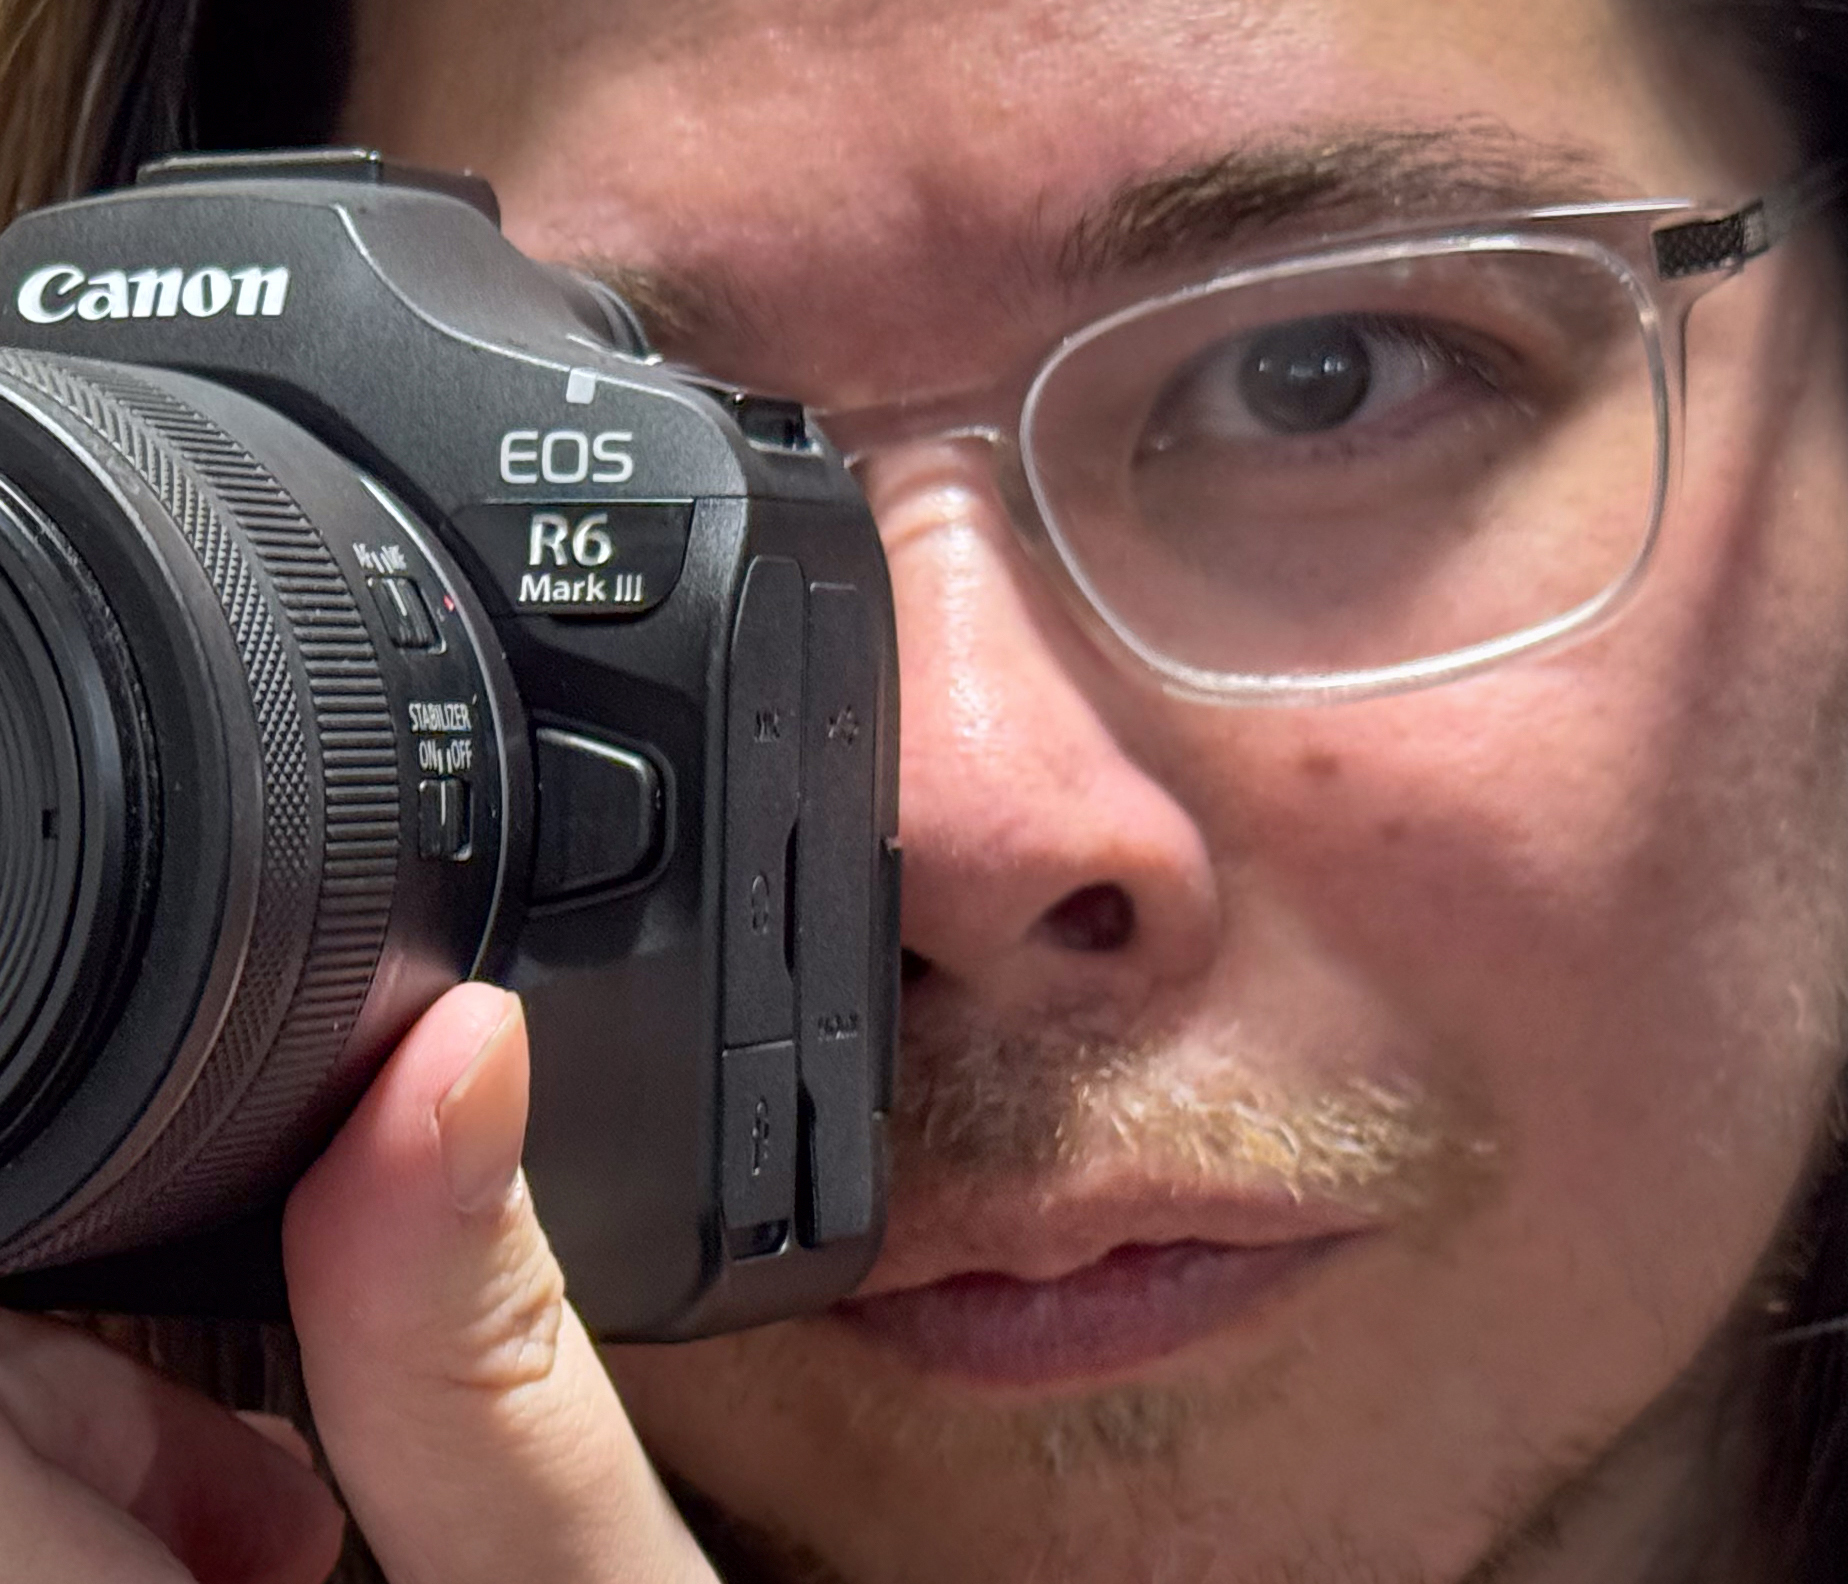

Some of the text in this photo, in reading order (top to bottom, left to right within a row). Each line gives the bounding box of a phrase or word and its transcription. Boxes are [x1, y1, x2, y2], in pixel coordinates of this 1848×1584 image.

[17, 263, 289, 324] Canon
[500, 430, 634, 484] EOS
[528, 513, 613, 567] R6
[518, 573, 642, 602] Mark III
[409, 703, 472, 732] STABILIZER
[419, 739, 473, 771] ON OFF
